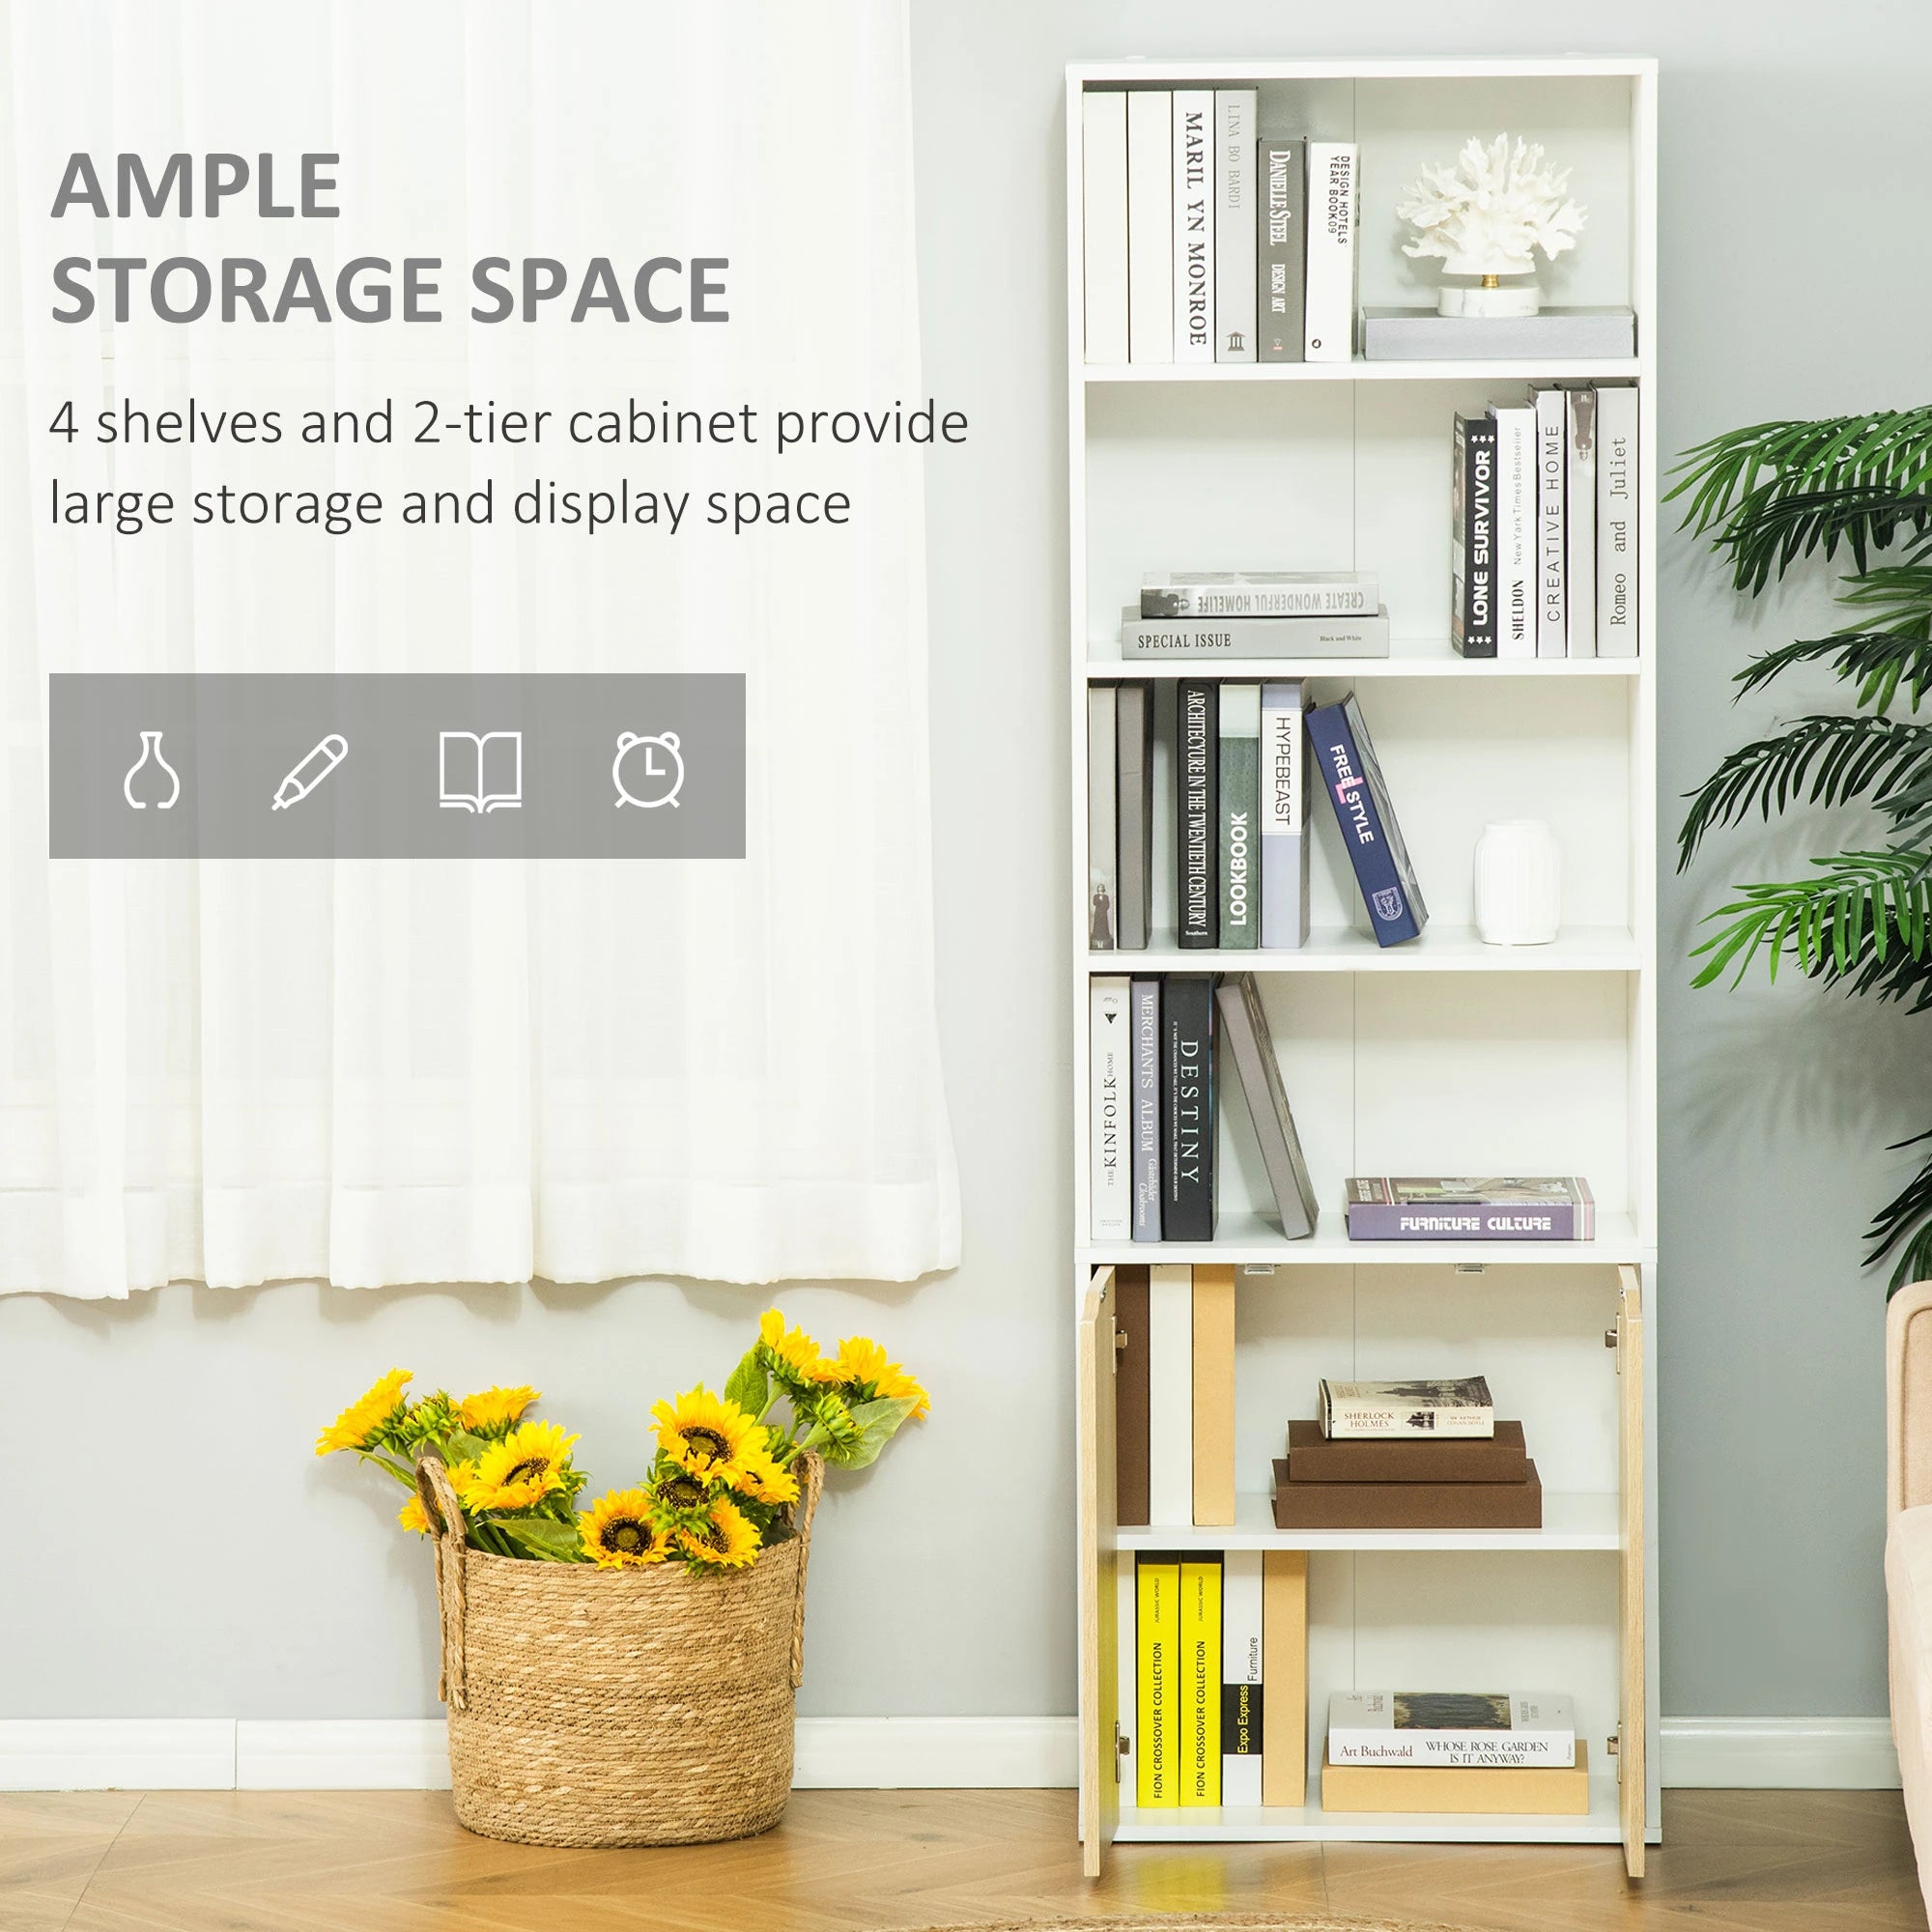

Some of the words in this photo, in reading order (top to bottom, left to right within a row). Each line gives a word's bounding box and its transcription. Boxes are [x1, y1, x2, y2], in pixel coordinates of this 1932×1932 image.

[1228, 104, 1240, 137] LINA
[1228, 146, 1240, 162] BO
[1329, 156, 1340, 185] YEAR
[1228, 170, 1240, 209] BARDI
[1340, 156, 1350, 196] DESIGN
[1338, 201, 1349, 244] HOTELS
[1188, 242, 1207, 346] MONROE
[1271, 264, 1286, 294] DESIGN
[1271, 297, 1286, 313] ART
[1546, 426, 1559, 490] HOME
[1610, 437, 1629, 499] Juliet
[1473, 450, 1491, 565] SURVIVOR
[1610, 521, 1626, 552] and
[1546, 505, 1560, 622] CREATIVE
[1198, 595, 1251, 612] HOMELIFE
[1255, 593, 1321, 611] WONDERFUL
[1324, 592, 1364, 610] CREATE
[1473, 572, 1489, 626] LONE
[1512, 580, 1524, 640] SHELDON
[1610, 573, 1626, 625] Romeo
[1138, 635, 1190, 648] SPECIAL
[1195, 634, 1232, 647] ISSUE
[1188, 776, 1206, 788] IN
[1275, 718, 1291, 825] HYPEBEAST
[1188, 790, 1206, 810] THE
[1188, 812, 1207, 875] TWENTIETH
[1230, 812, 1247, 925] LOOKBOOK
[1188, 877, 1207, 927] CENTURY
[1141, 994, 1153, 1089] MERCHANTS
[1104, 1077, 1116, 1167] KINFOLK
[1141, 1099, 1153, 1151] ALBUM
[1180, 1040, 1199, 1183] DESTINY
[1401, 1217, 1480, 1231] FURNITURE
[1488, 1217, 1551, 1231] CULTURE
[1344, 1411, 1395, 1420] SHERLOCK
[1152, 1642, 1162, 1706] COLLECTION
[1196, 1641, 1206, 1704] COLLECTION
[1247, 1637, 1258, 1681] Furniture
[1237, 1685, 1250, 1725] Express
[1152, 1709, 1162, 1771] CROSSOVER
[1196, 1707, 1206, 1769] CROSSOVER
[1237, 1727, 1250, 1753] Expo
[1340, 1746, 1356, 1756] Art
[1360, 1745, 1412, 1757] Buchwald
[1425, 1741, 1467, 1752] WHOSE
[1470, 1742, 1497, 1752] ROSE
[1501, 1742, 1548, 1752] GARDEN
[1450, 1753, 1458, 1764] IS
[1462, 1753, 1473, 1764] IT
[1477, 1753, 1524, 1764] ANYWAY?
[1153, 1775, 1162, 1799] FION
[1196, 1772, 1205, 1797] FION
